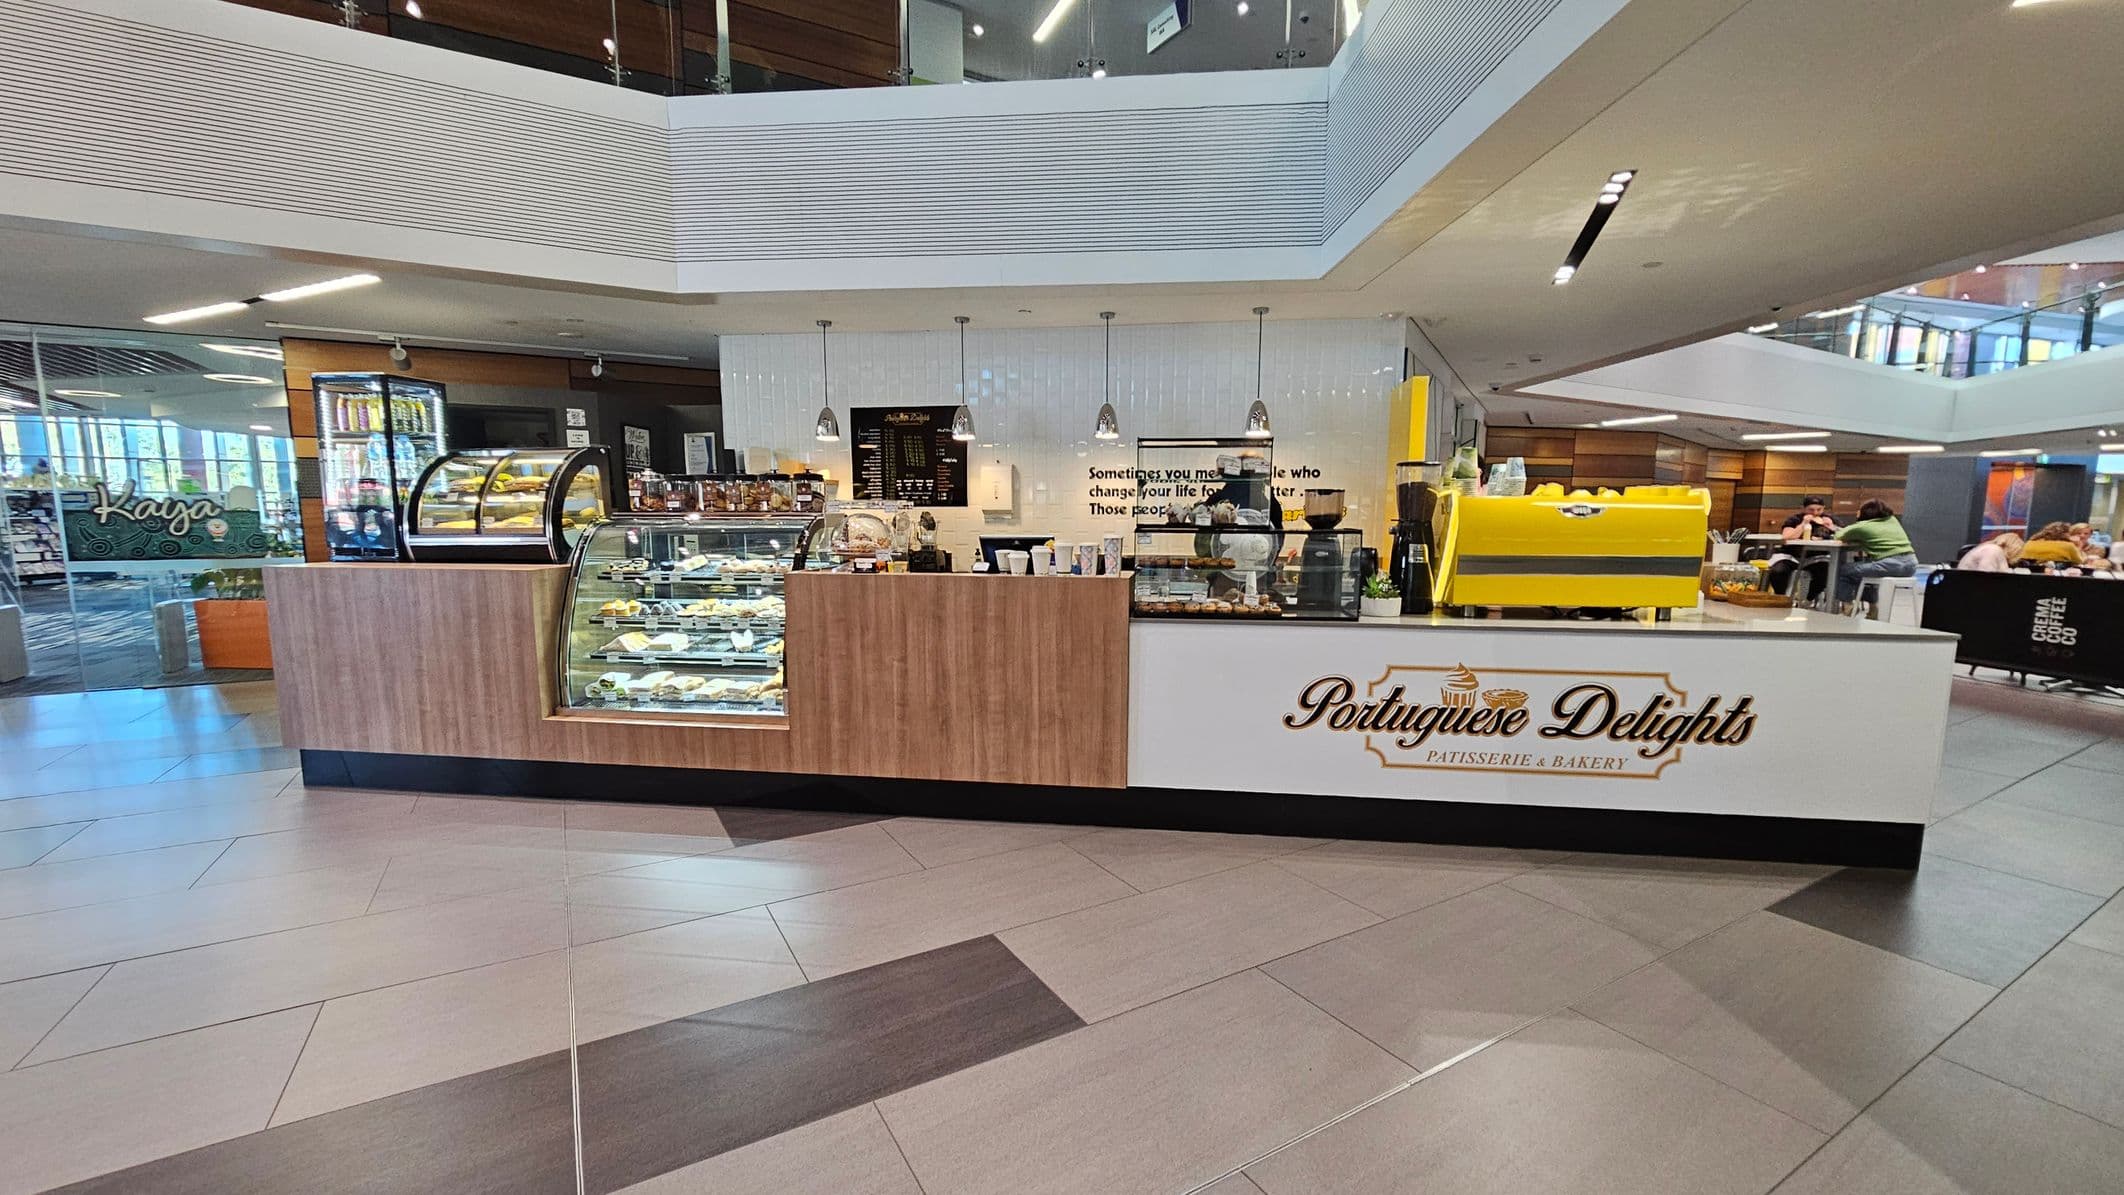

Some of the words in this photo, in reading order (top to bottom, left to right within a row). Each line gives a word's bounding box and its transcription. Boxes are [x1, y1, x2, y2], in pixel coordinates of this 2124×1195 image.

[1089, 466, 1161, 480] Sometimes
[1165, 469, 1190, 480] you
[1195, 469, 1216, 479] me
[1290, 466, 1321, 479] who
[1089, 485, 1136, 500] change
[1140, 487, 1172, 500] your
[1175, 485, 1197, 497] life
[92, 479, 223, 537] Kaya
[1089, 503, 1127, 515] Those
[1132, 506, 1166, 518] peop
[2031, 598, 2052, 642] CREMA
[2046, 596, 2067, 644] COFFEE
[2061, 627, 2078, 646] CO
[1283, 673, 1530, 750] Portuguese
[1537, 681, 1758, 760] Delights
[1426, 750, 1532, 767] PATISSERIE
[1536, 756, 1546, 768] &
[1552, 754, 1630, 771] BAKERY
